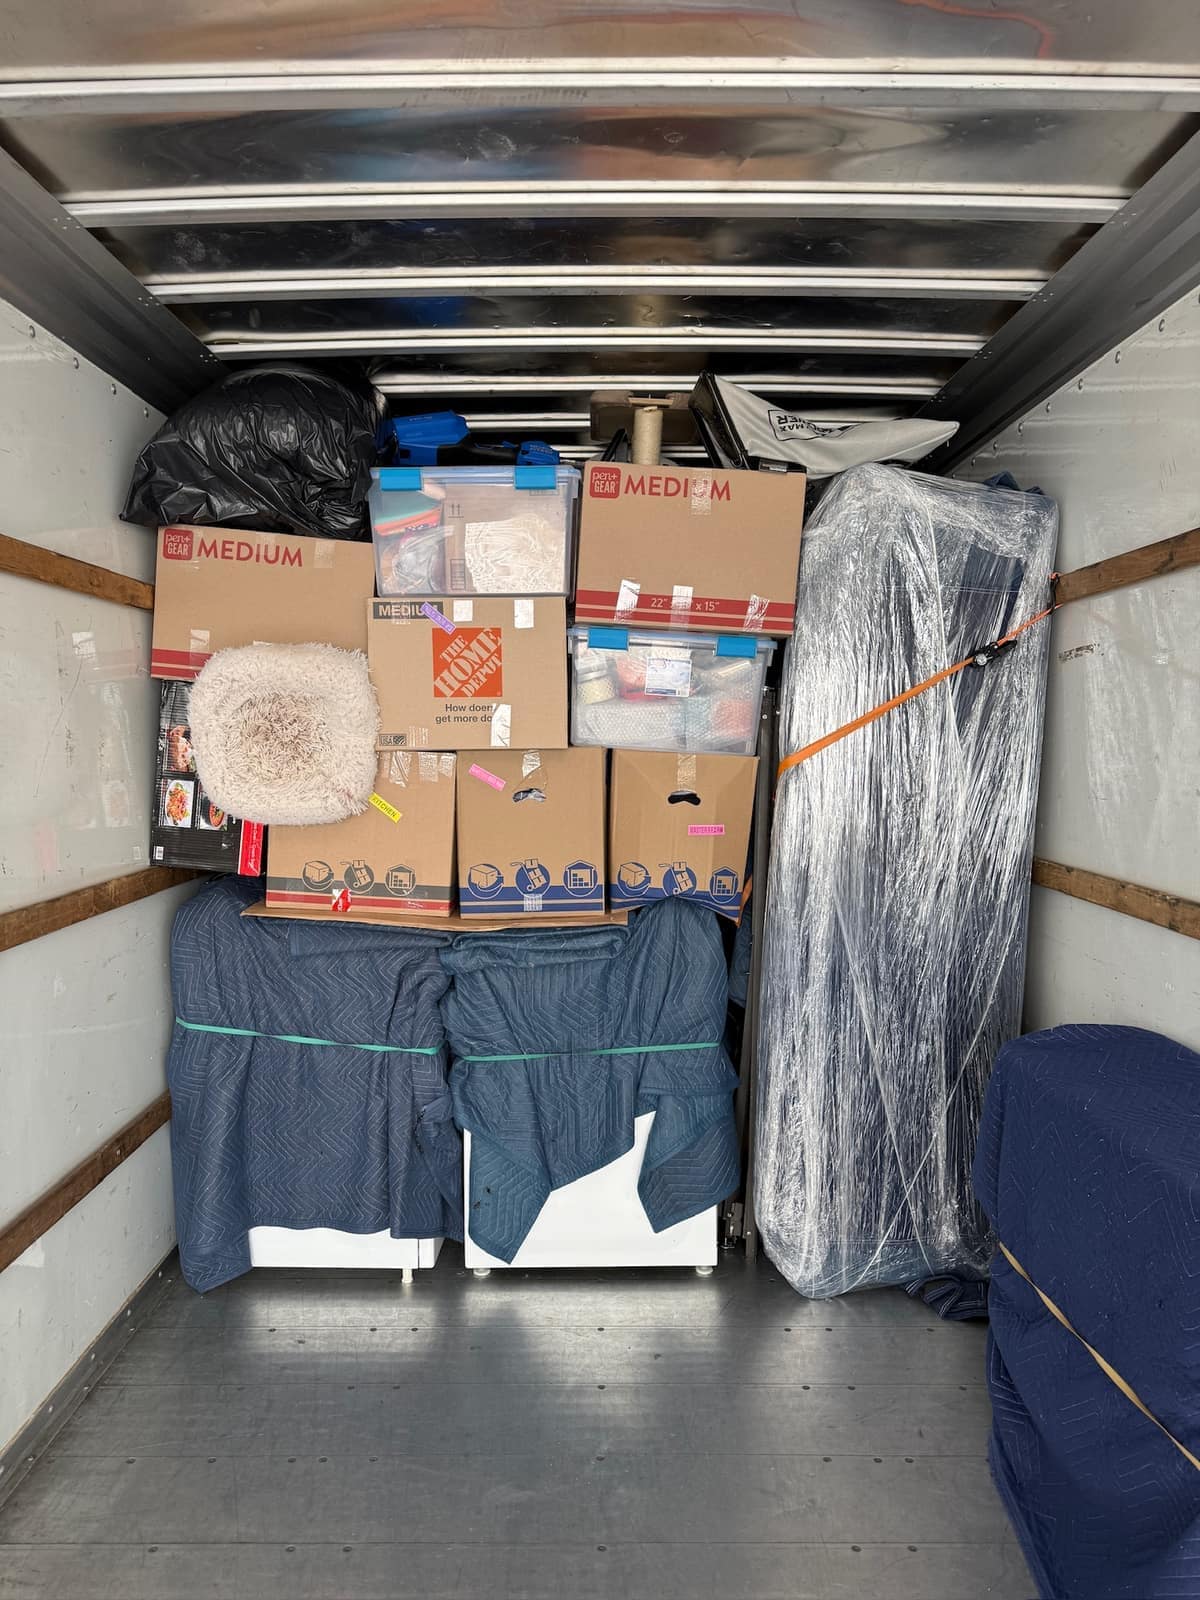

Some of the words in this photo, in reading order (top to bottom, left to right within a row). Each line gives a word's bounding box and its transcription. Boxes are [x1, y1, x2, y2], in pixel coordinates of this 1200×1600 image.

[779, 422, 804, 433] MAX
[593, 482, 616, 494] GEAR
[624, 475, 731, 501] MEDIUM
[167, 543, 189, 556] GEAR
[197, 538, 303, 568] MEDIUM
[379, 604, 437, 617] MEDIU
[440, 635, 468, 663] THE
[434, 627, 502, 698] HOME
[460, 653, 502, 698] DEPOT
[445, 704, 467, 712] How
[435, 715, 451, 725] get
[453, 715, 478, 723] more
